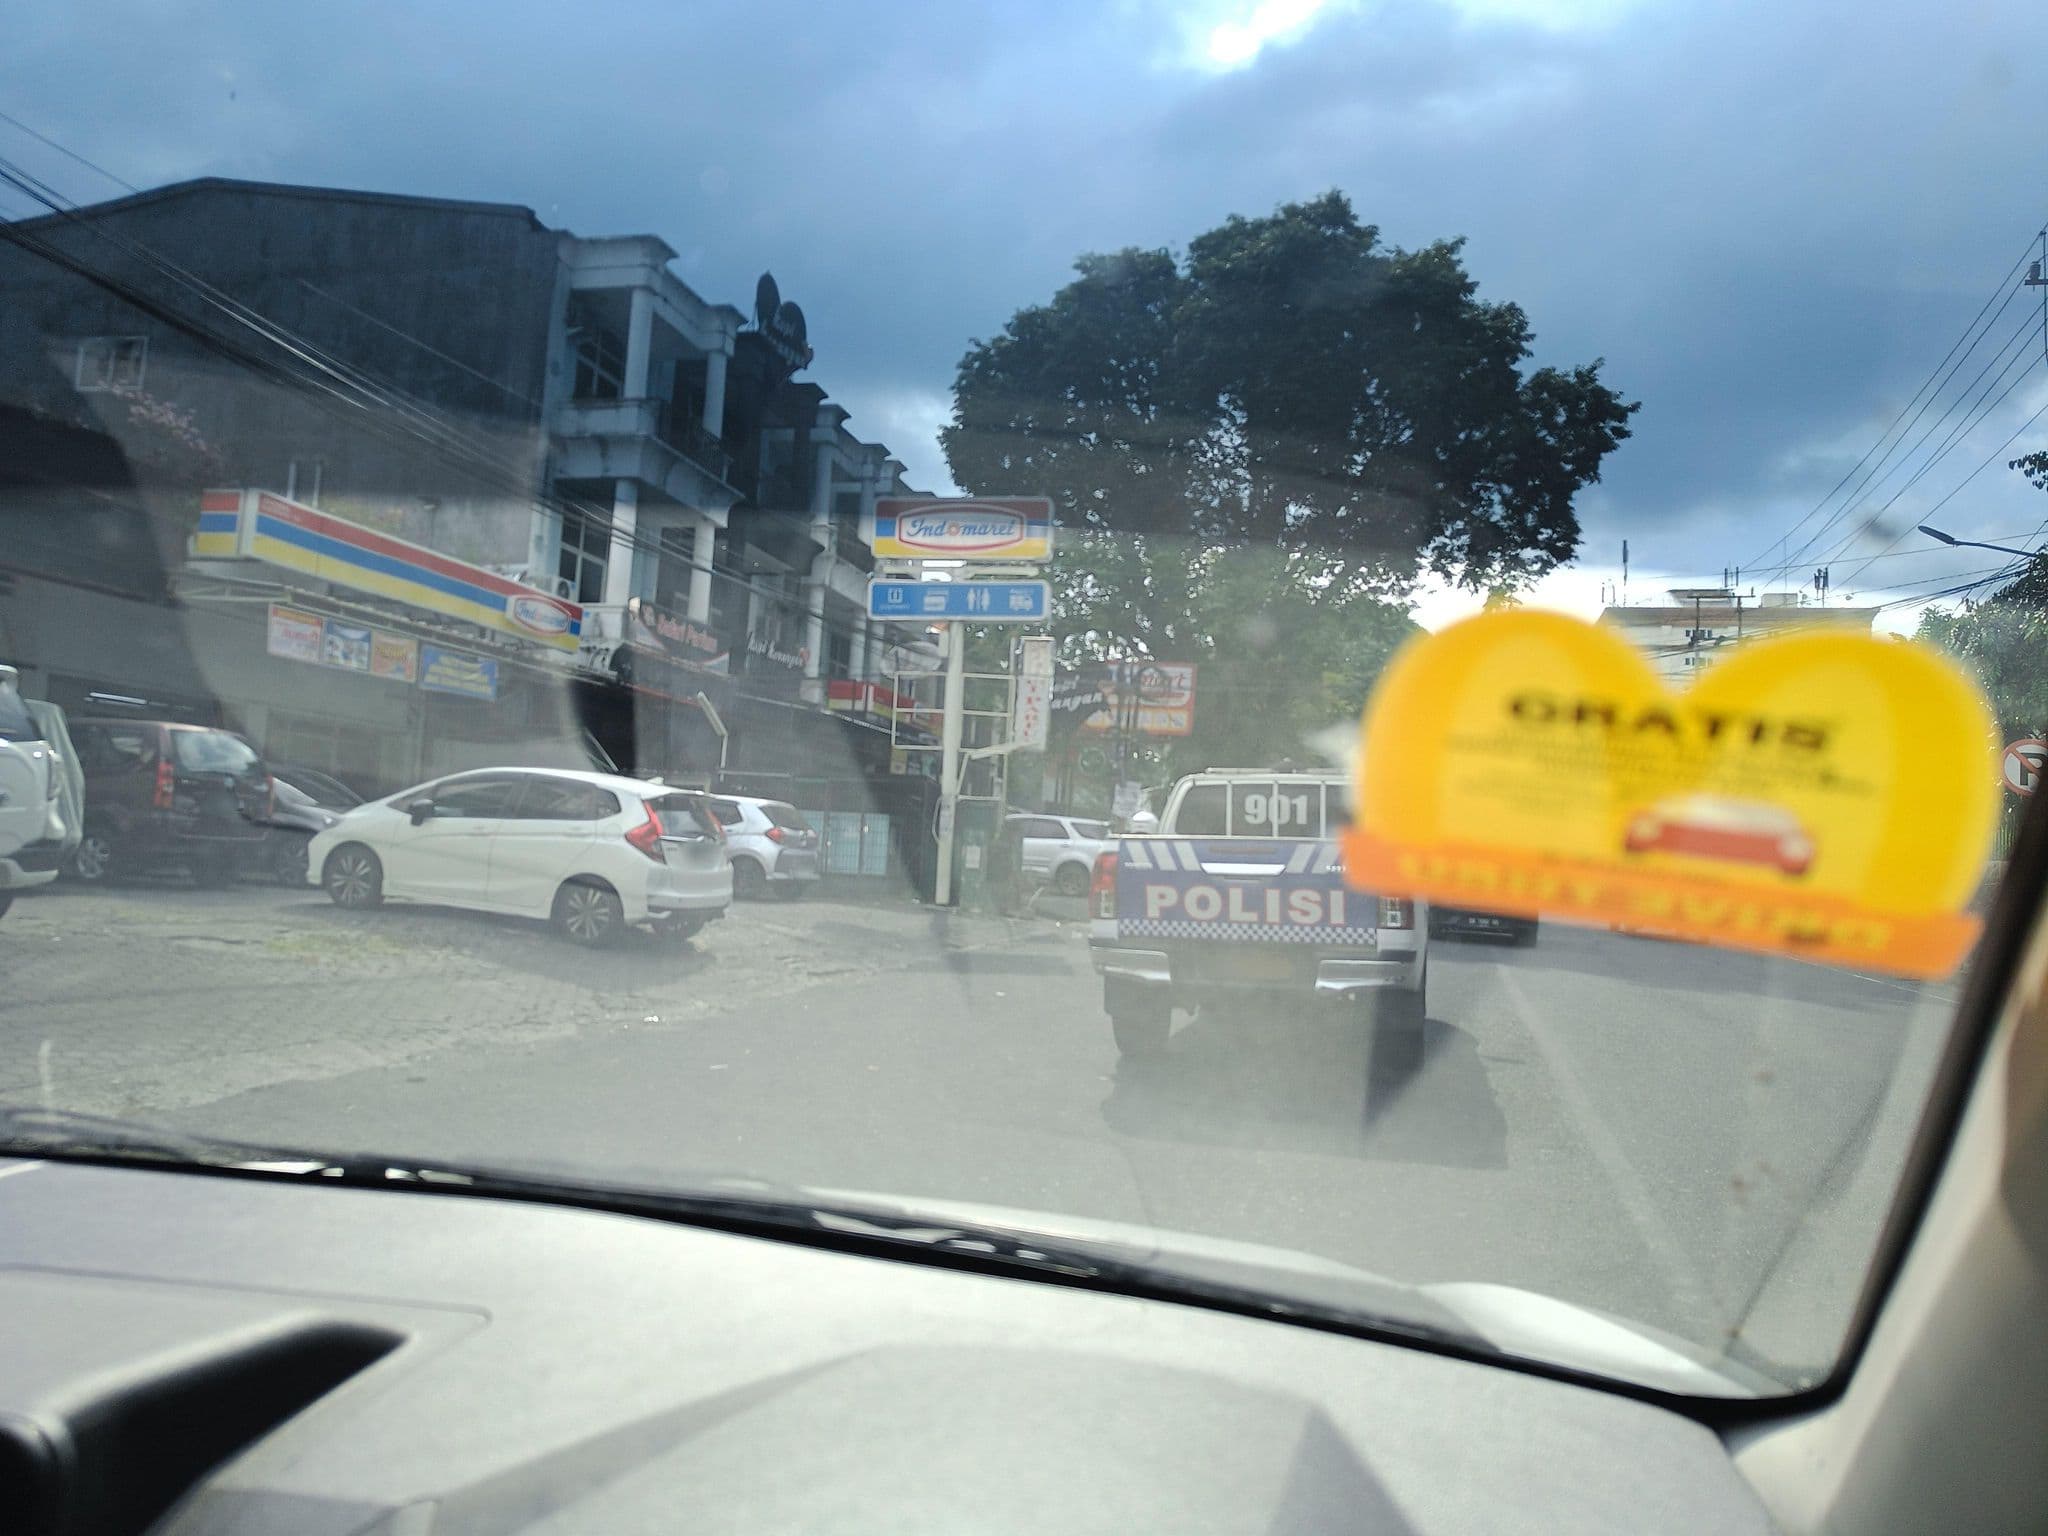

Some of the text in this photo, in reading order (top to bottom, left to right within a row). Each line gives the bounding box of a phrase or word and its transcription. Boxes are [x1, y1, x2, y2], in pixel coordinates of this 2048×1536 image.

[906, 519, 1015, 537] Indomaret
[1508, 694, 1832, 752] GRATIS
[1244, 794, 1309, 825] 901
[1145, 884, 1346, 926] POLISI
